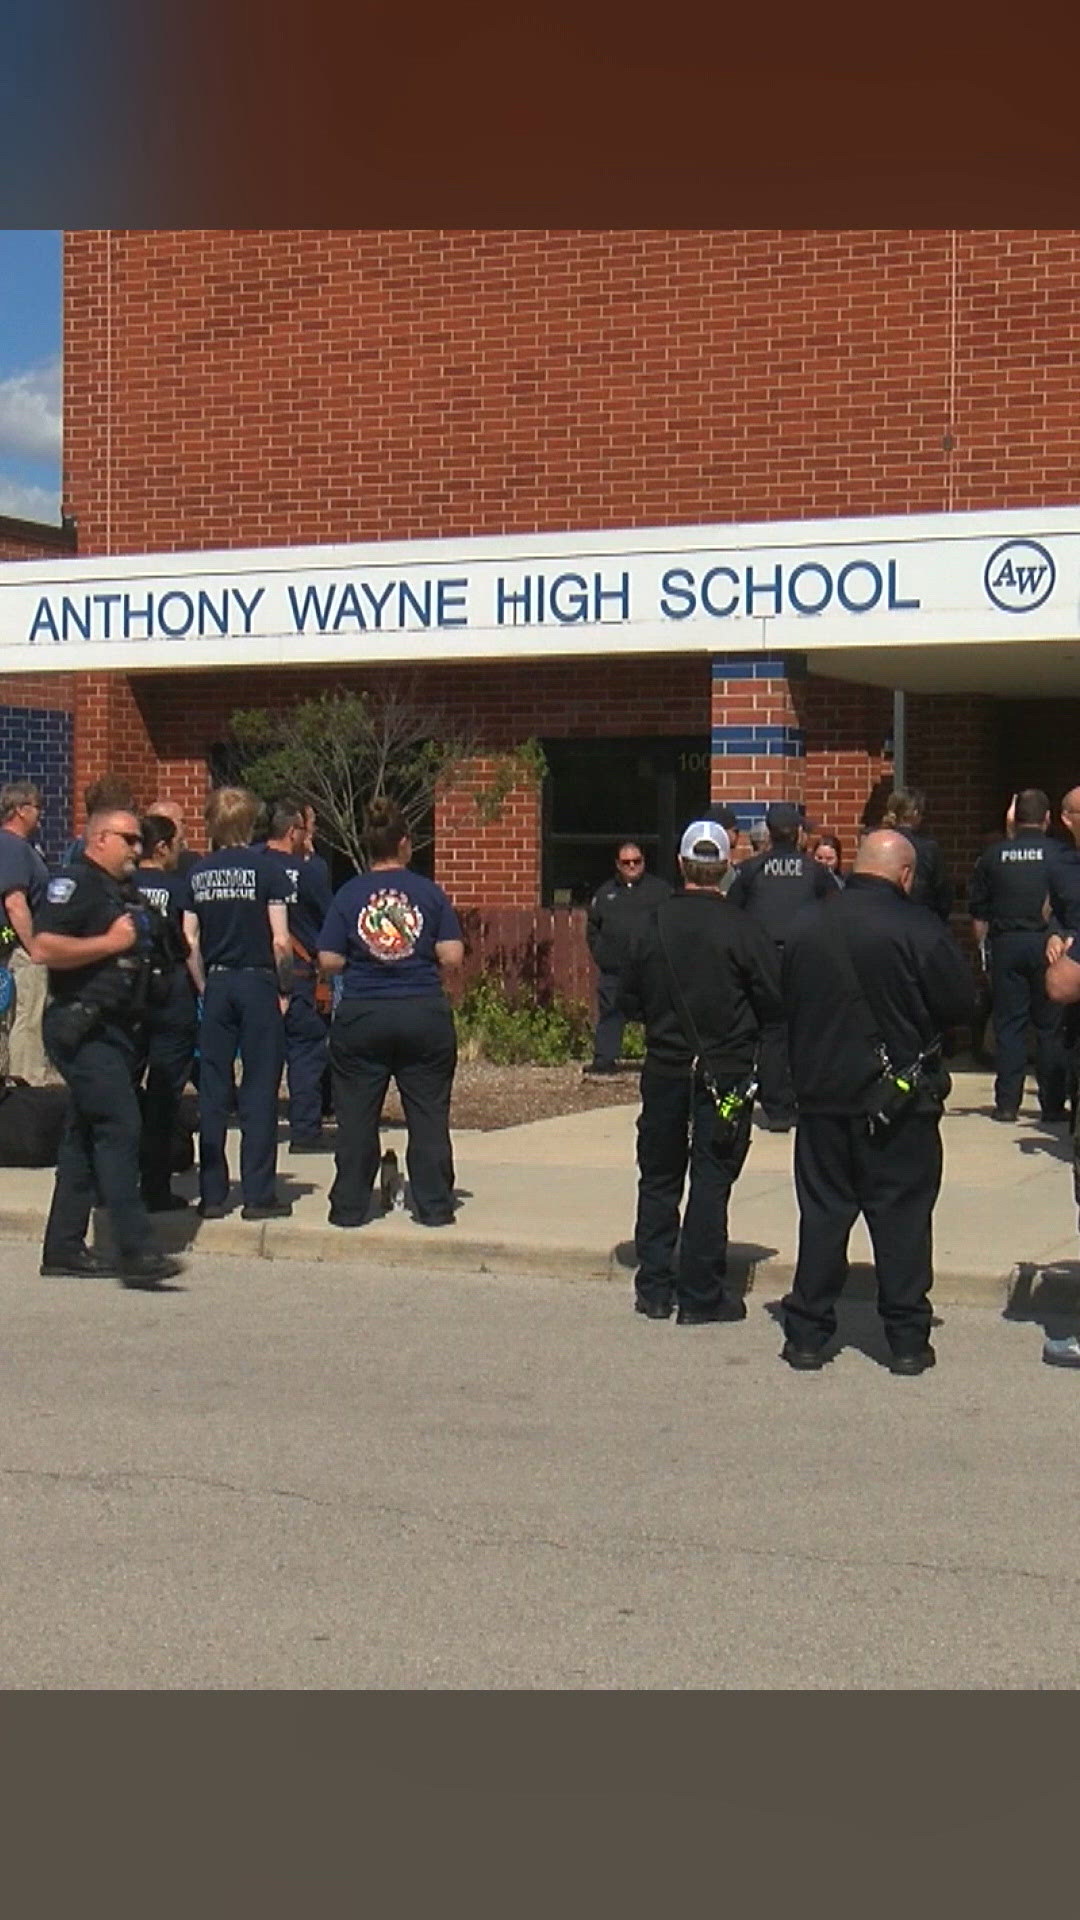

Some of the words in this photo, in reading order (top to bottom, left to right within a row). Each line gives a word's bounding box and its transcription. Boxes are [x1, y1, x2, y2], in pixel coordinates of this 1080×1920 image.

[992, 557, 1048, 596] AW
[29, 587, 266, 642] ANTHONY
[287, 578, 469, 632] WAYNE
[497, 571, 630, 625] HIGH
[660, 558, 921, 620] SCHOOL
[764, 857, 803, 877] POLICE
[1001, 848, 1044, 863] POLICE
